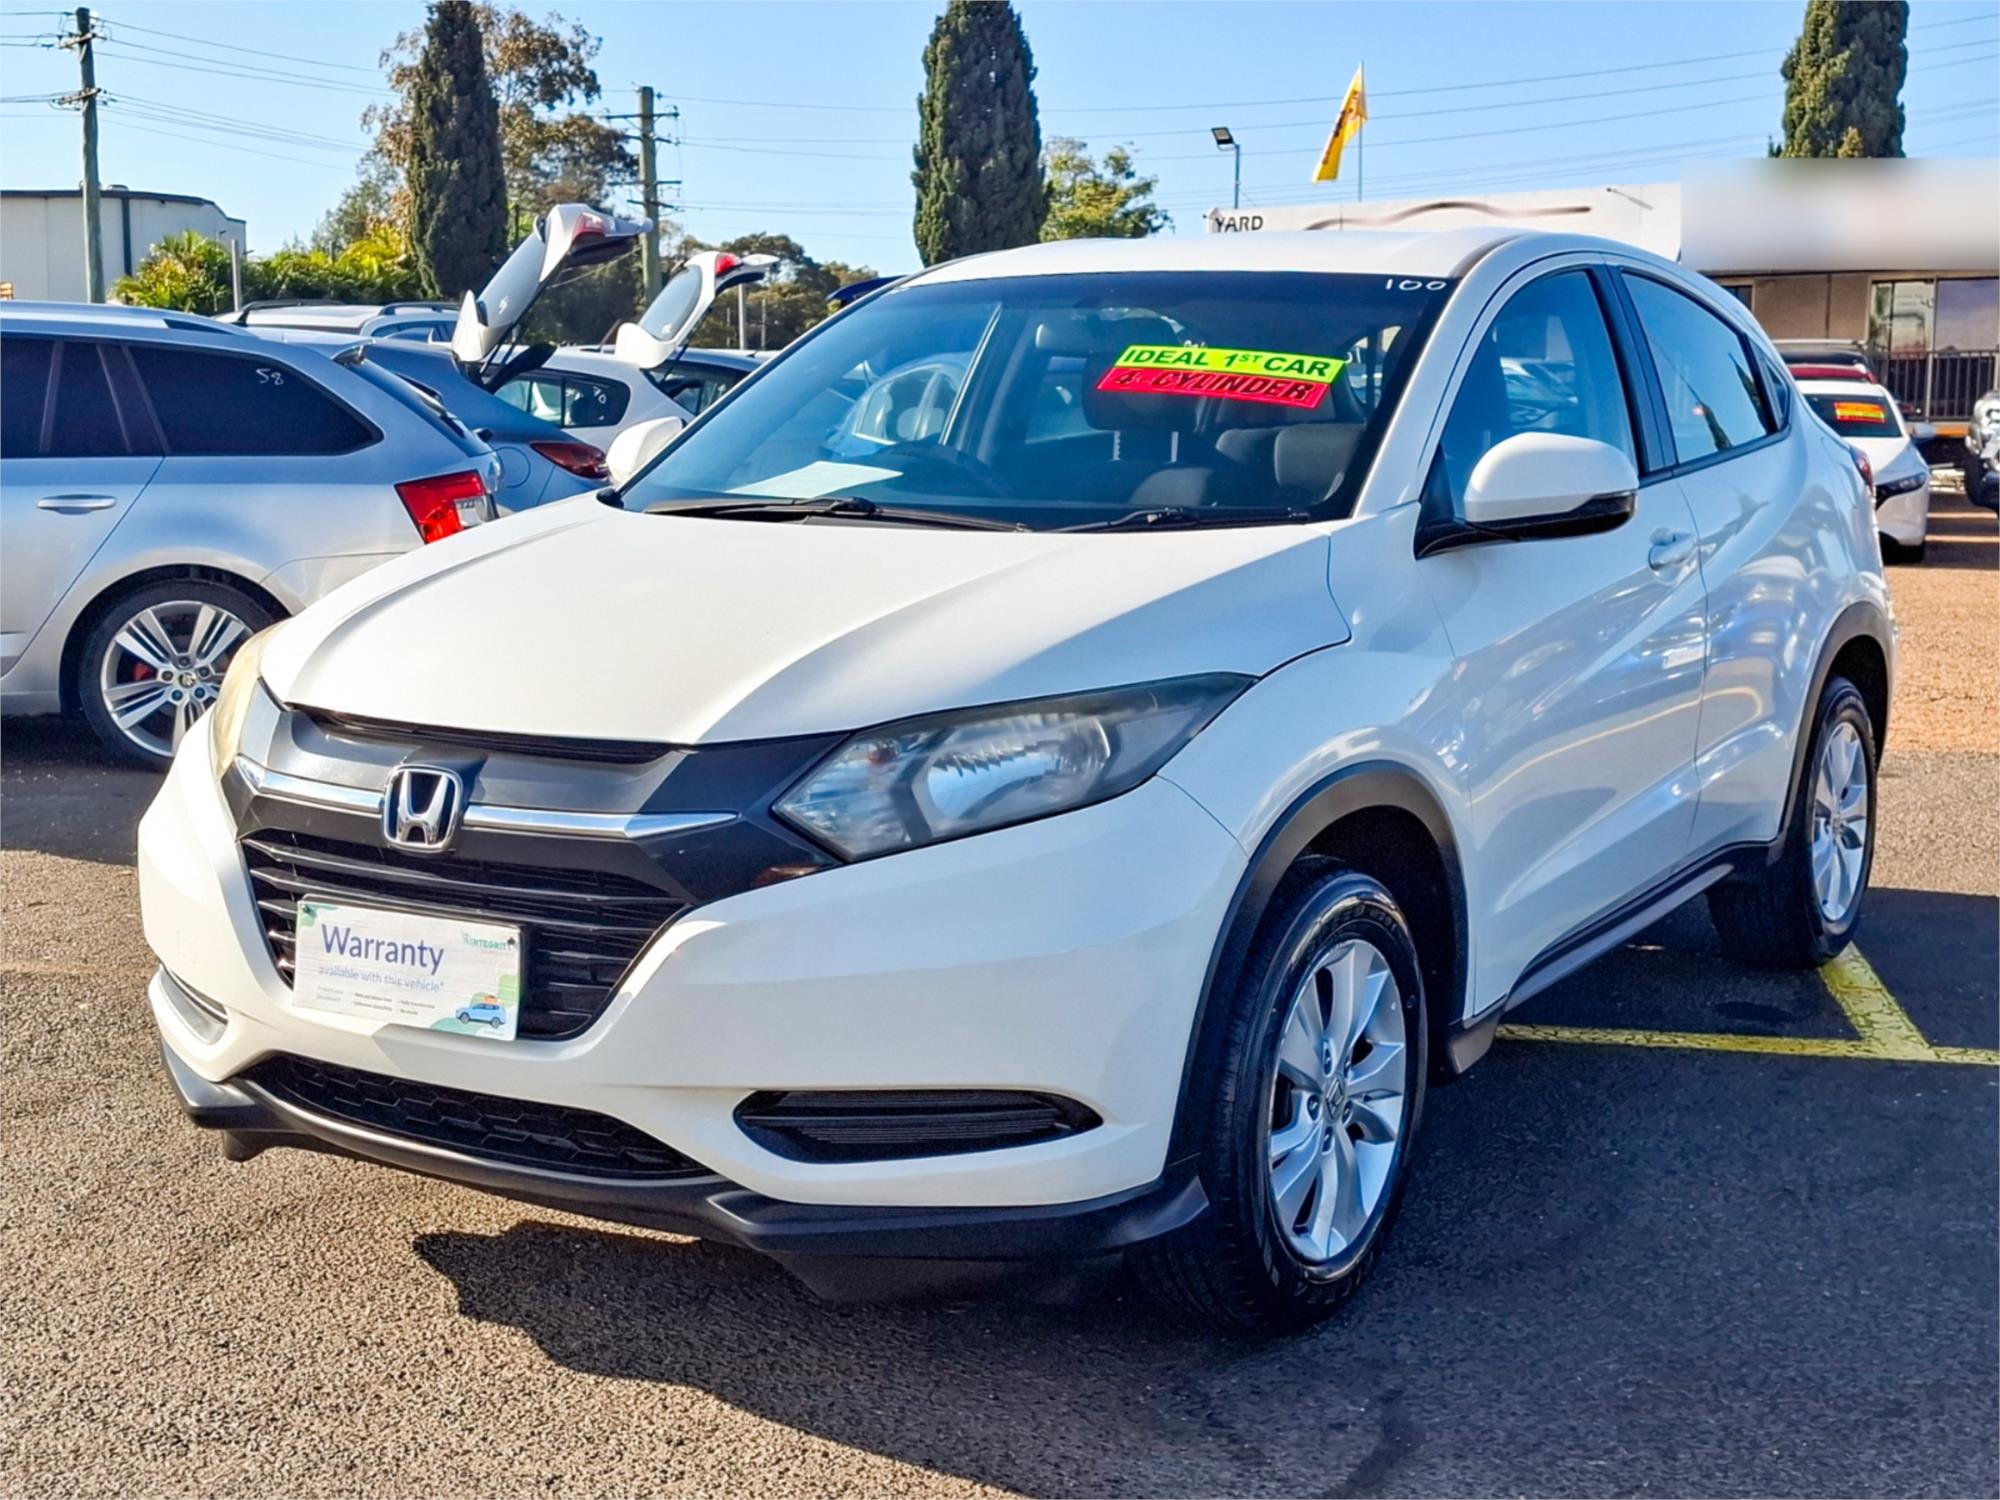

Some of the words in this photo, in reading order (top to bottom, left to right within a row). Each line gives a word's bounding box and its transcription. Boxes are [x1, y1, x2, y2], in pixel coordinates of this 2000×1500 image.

[1215, 215, 1263, 233] YARD
[1385, 279, 1447, 291] 100
[1124, 349, 1209, 367] IDEAL
[1224, 353, 1263, 367] 1ST
[1264, 357, 1331, 377] CAR
[255, 368, 284, 386] 58
[321, 924, 444, 975] Warranty
[318, 965, 359, 980] available
[360, 971, 382, 985] with
[384, 975, 402, 987] this
